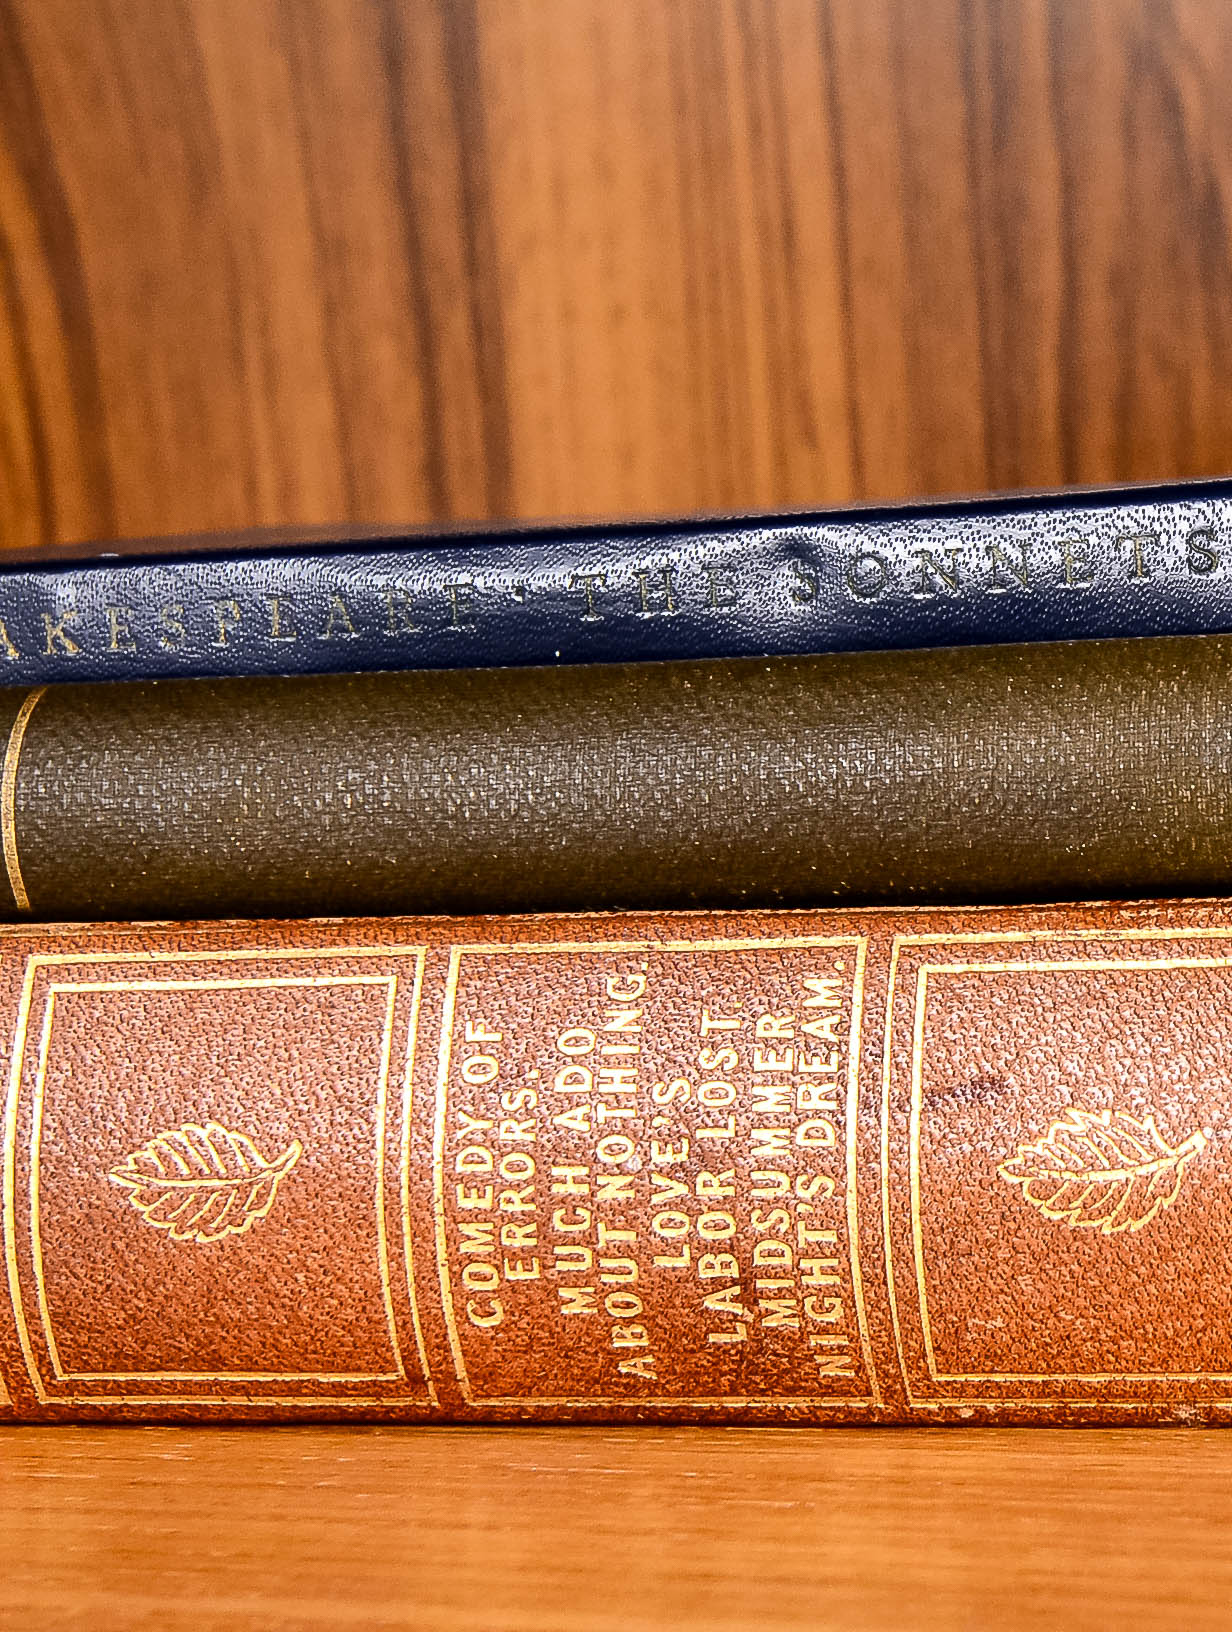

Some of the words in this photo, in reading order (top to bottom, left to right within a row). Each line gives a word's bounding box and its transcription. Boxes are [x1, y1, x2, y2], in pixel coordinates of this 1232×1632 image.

[570, 566, 738, 622] THE
[786, 525, 1222, 609] SONNETS
[461, 1018, 503, 1085] OF
[552, 1026, 597, 1132] ADO
[594, 963, 650, 1201] NOTHING.
[794, 960, 846, 1150] DREAM.
[456, 1108, 505, 1328] COMEDY
[499, 1067, 543, 1281] ERRORS.
[551, 1164, 599, 1315] MUCH
[649, 1076, 693, 1268] LOVE'S
[694, 1167, 754, 1344] LABOR
[749, 1010, 802, 1329] MIDSUMMER
[596, 1221, 659, 1381] ABOUT
[794, 1171, 856, 1379] NIGHT'S
